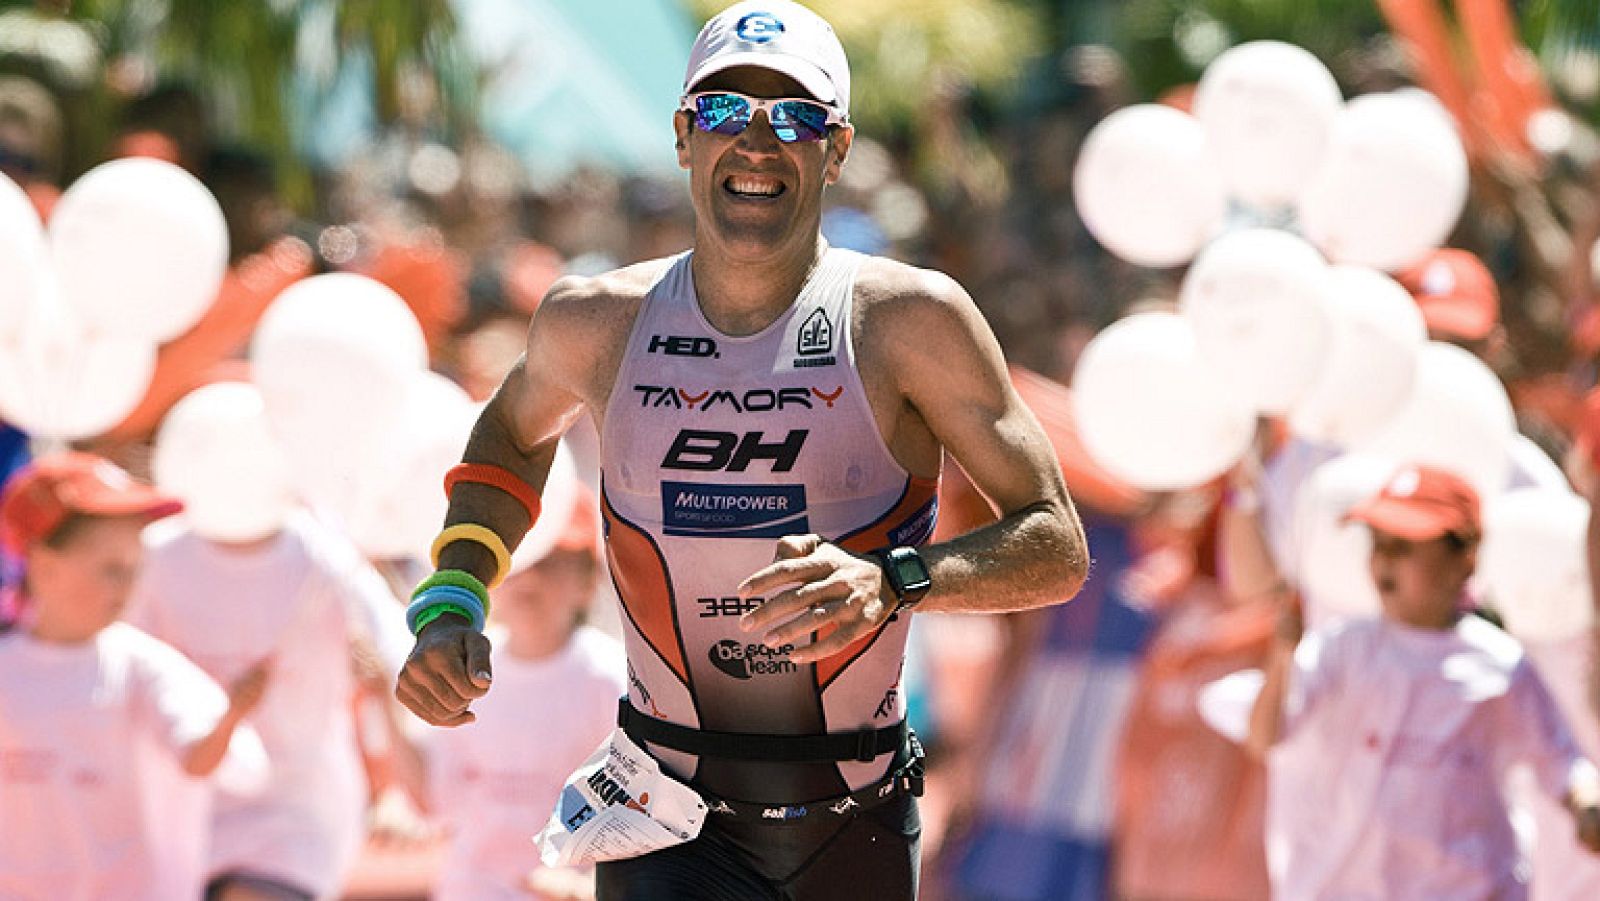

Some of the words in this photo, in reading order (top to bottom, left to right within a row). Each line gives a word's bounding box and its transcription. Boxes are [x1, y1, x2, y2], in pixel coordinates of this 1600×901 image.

[648, 335, 720, 359] HED.
[634, 385, 844, 413] TAYMORY
[661, 429, 809, 471] BH
[675, 492, 788, 510] MULTIPOWER
